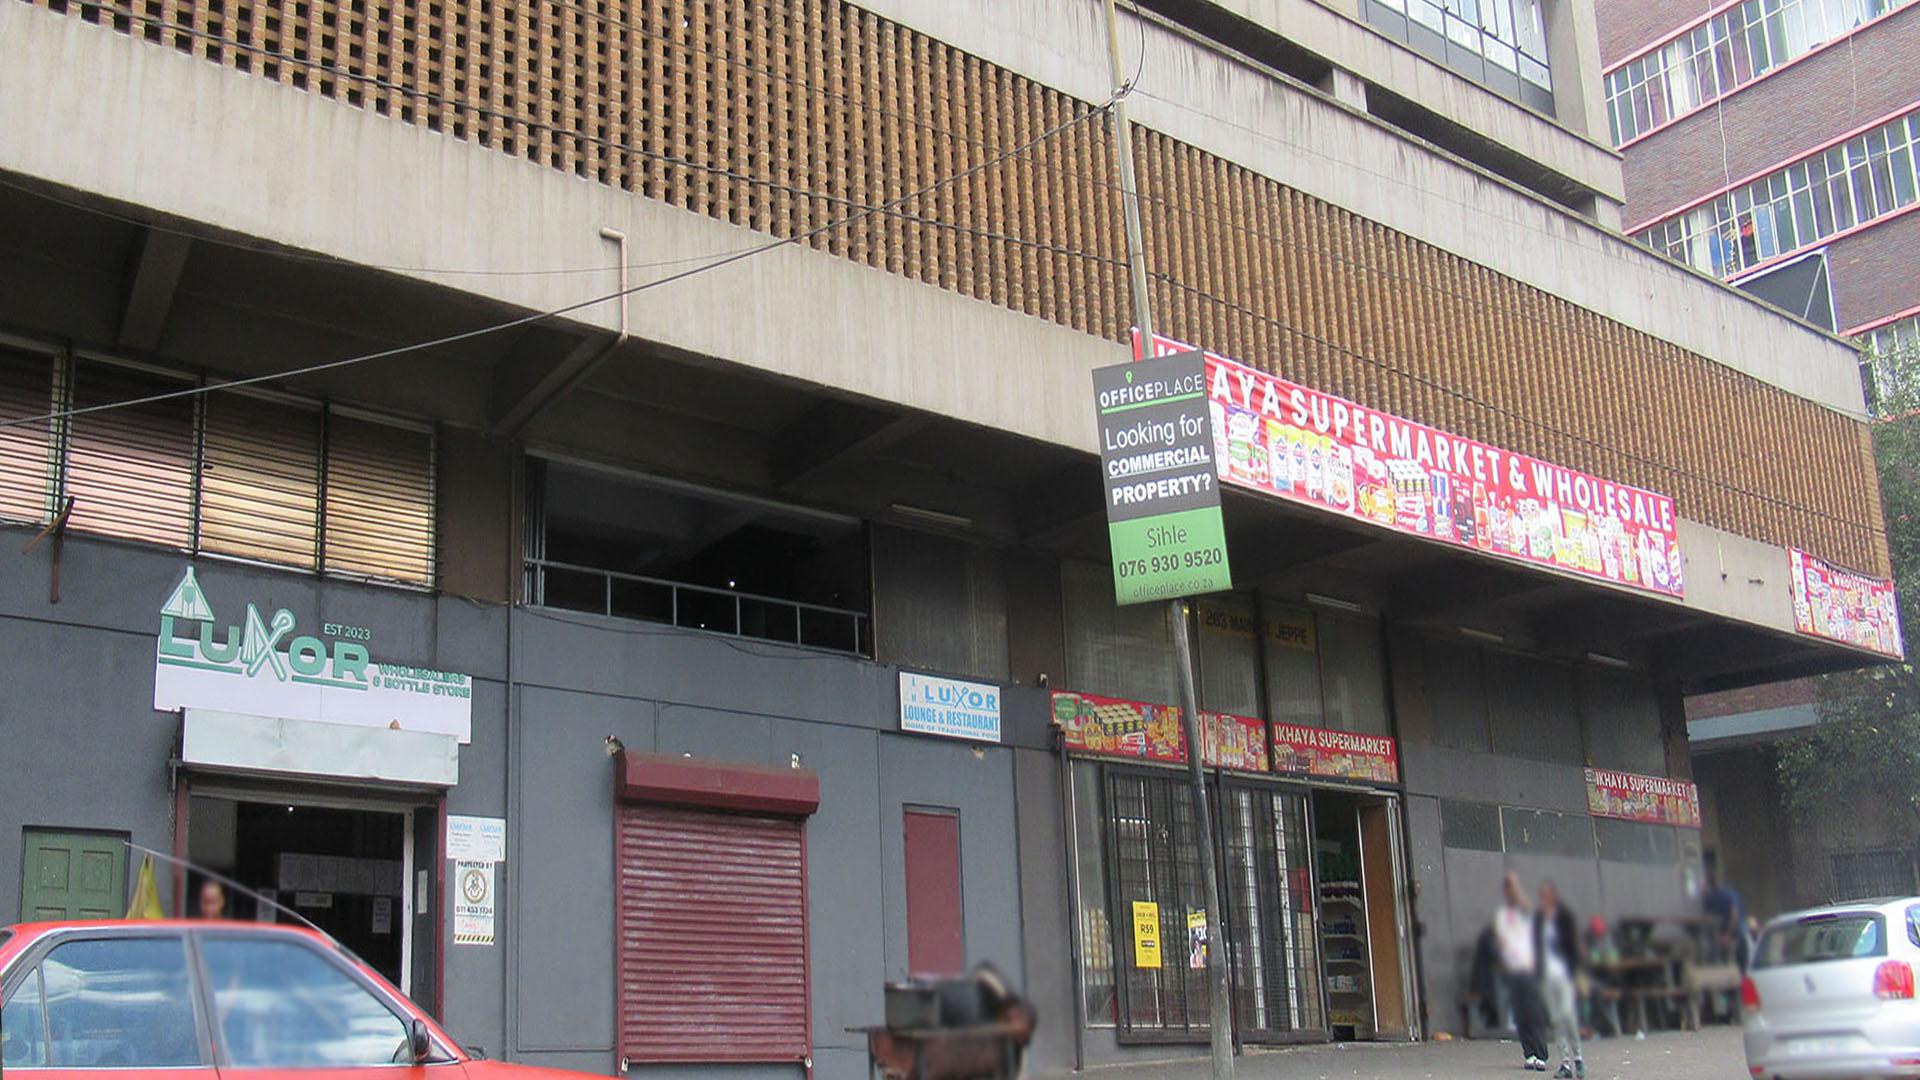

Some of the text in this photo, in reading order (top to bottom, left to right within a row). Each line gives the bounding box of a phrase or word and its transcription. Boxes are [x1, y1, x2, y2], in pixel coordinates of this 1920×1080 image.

[1100, 374, 1203, 408] OFFICEPLACE
[1105, 414, 1204, 450] Looking for
[1108, 445, 1210, 475] COMMERCIAL
[1290, 388, 1500, 485] SUPERMARKET
[1509, 456, 1527, 492] &
[1531, 462, 1673, 532] WHOLESALE
[1112, 473, 1212, 505] PROPERTY?
[1148, 525, 1187, 549] Sihle
[1119, 547, 1222, 578] 076 930 9520
[1133, 579, 1214, 598] officeplace.co.za
[159, 603, 370, 682] LUXOR
[324, 623, 372, 641] EST 2023
[379, 663, 466, 685] WHOLESALERS
[384, 677, 430, 694] BOTTLE
[432, 684, 470, 699] STORE
[924, 685, 996, 711] LUXOR
[904, 704, 999, 732] LOUNGE & RESTAURANT
[1275, 725, 1391, 755] IKHAYA SUPERMARKET
[1596, 771, 1687, 797] IKHAYA SUPERMARKET
